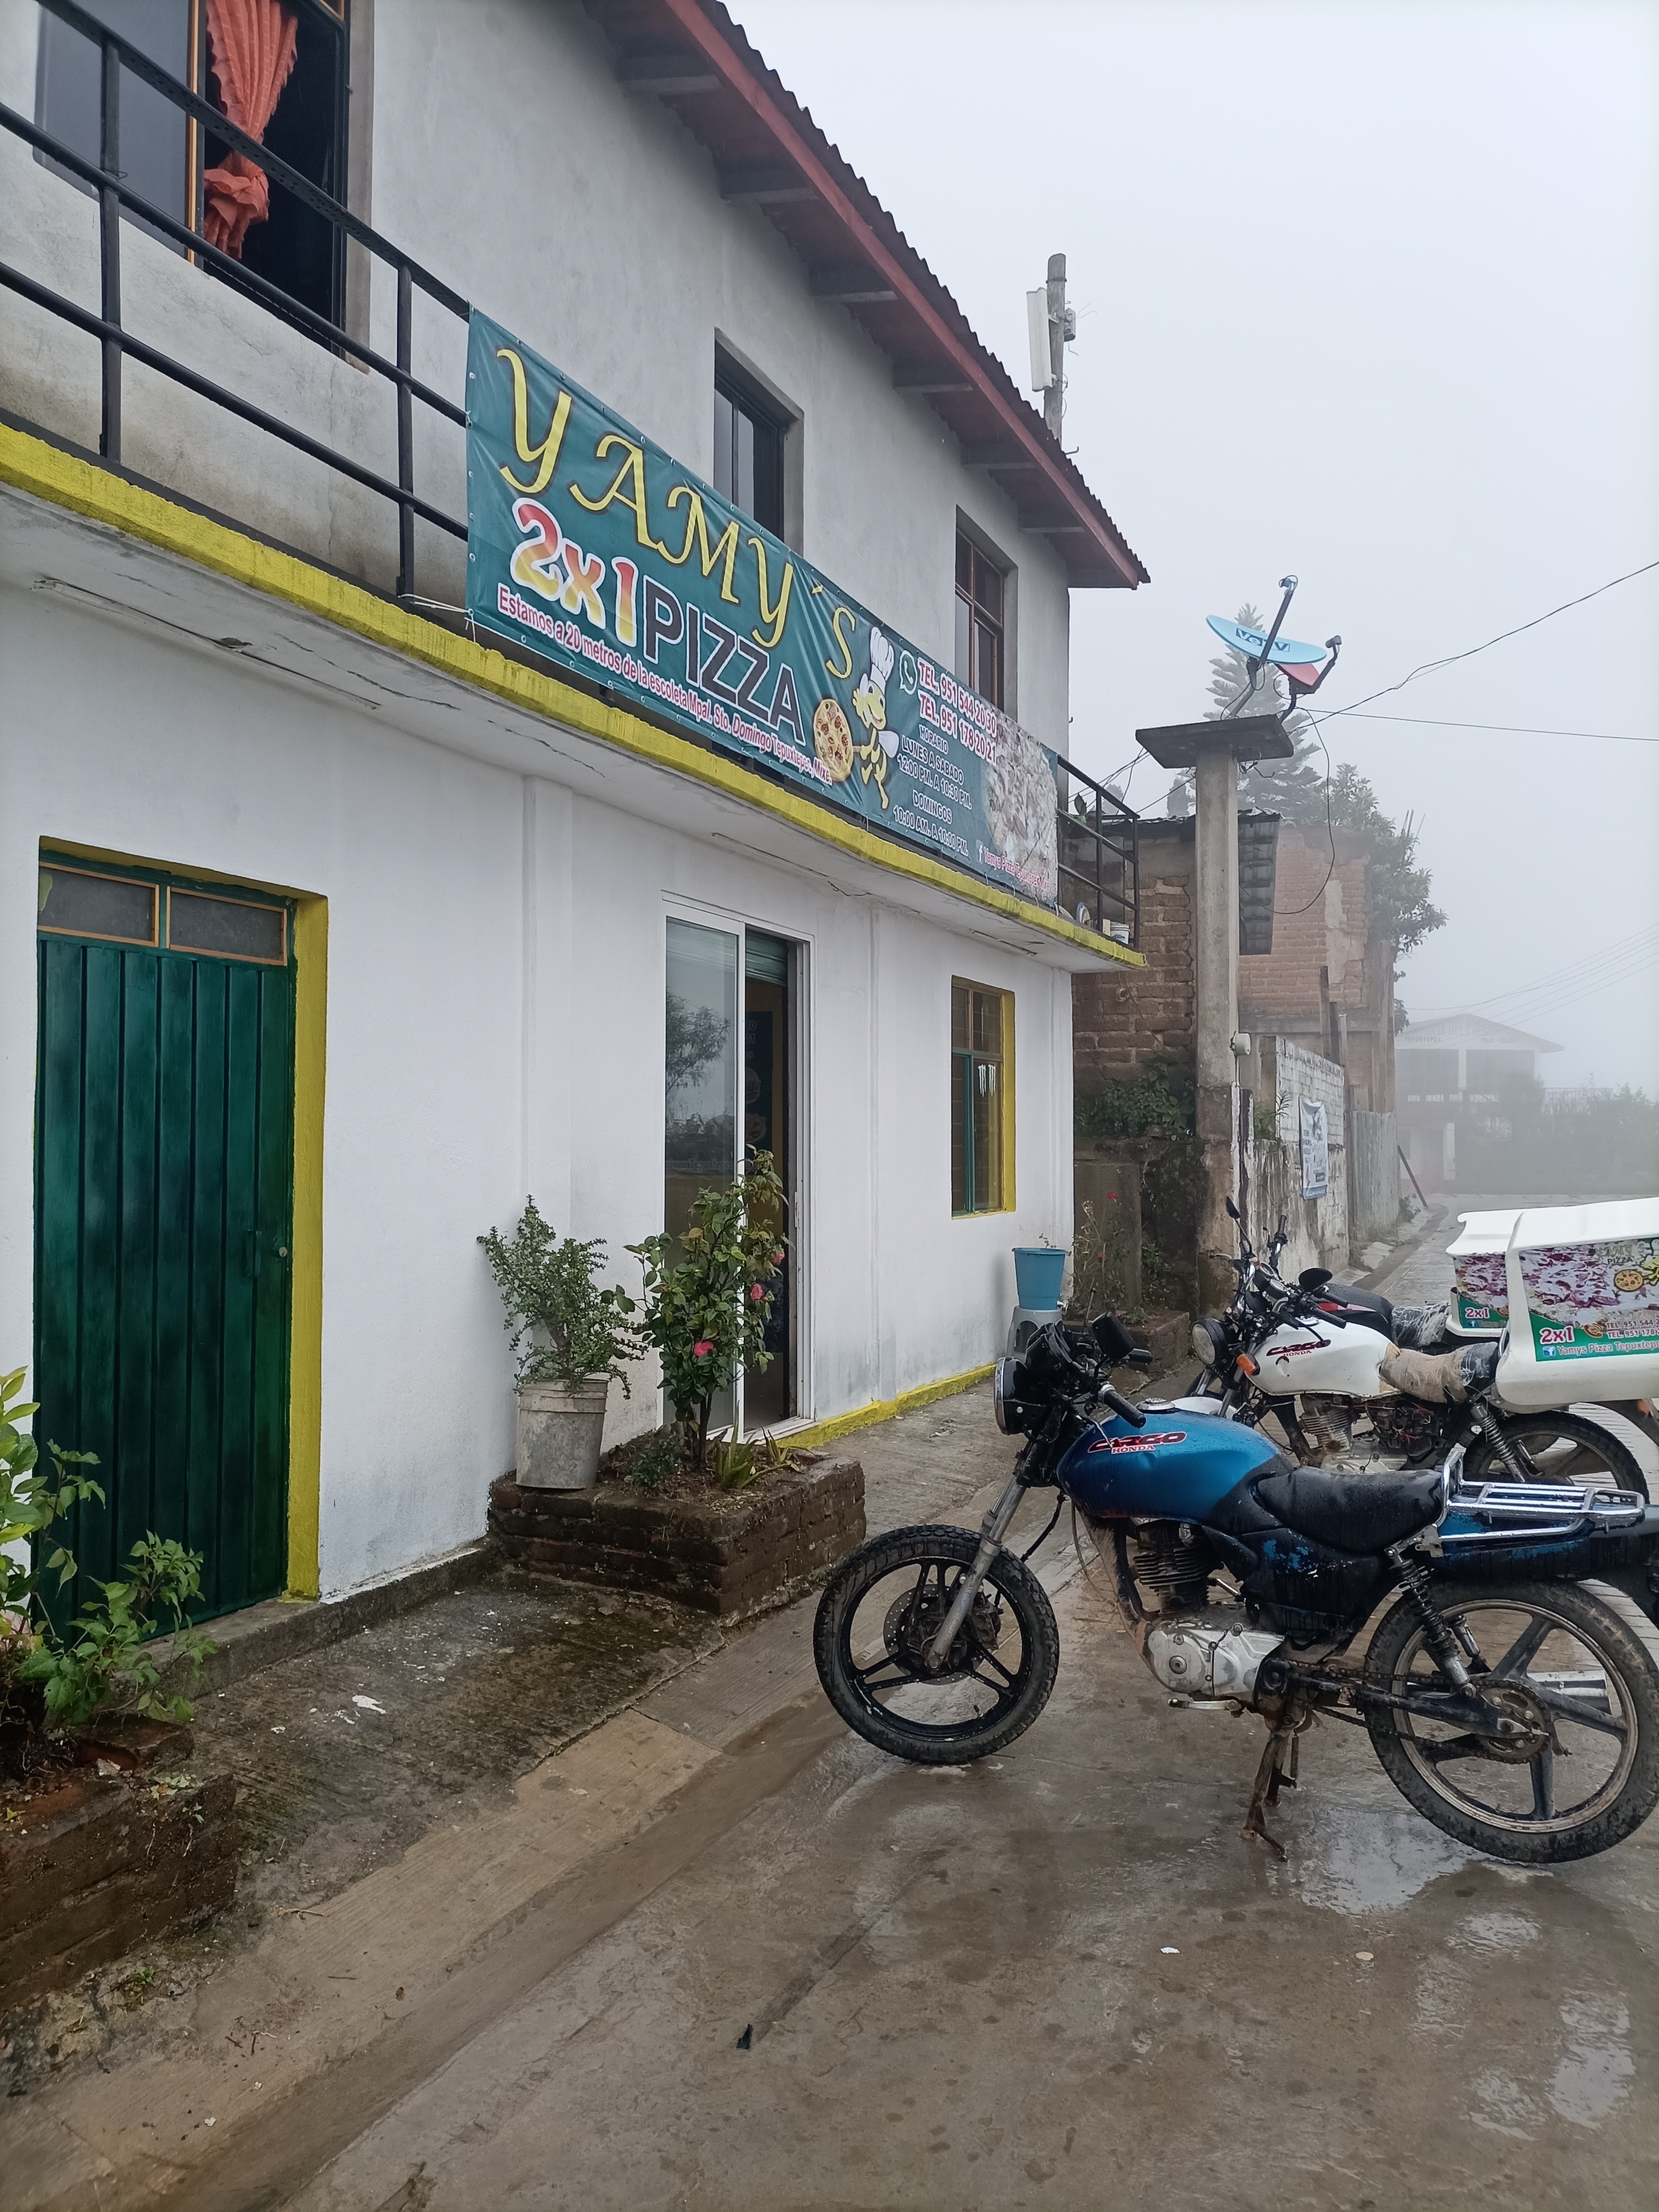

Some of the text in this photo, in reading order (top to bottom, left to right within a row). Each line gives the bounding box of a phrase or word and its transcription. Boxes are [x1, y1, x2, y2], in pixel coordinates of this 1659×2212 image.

[510, 498, 806, 746] 2x1 PIZZA
[498, 582, 554, 638] Estamos
[555, 621, 564, 645] a
[565, 621, 581, 652] 20
[581, 635, 621, 674] metros
[622, 654, 637, 682] de
[638, 660, 648, 688] la
[648, 672, 688, 711] escoleta
[688, 689, 712, 724] Mpal.
[714, 703, 731, 733] Sto.
[732, 713, 771, 753] Domingo
[917, 657, 997, 738] TEL. 951 544 20 30
[918, 690, 996, 766] TEL. 951 178 20 21
[919, 724, 948, 754] HORARIO
[902, 735, 964, 785] LUNES A SABADO
[898, 753, 972, 810] 12:00 PM. A 10:30 PM.
[913, 789, 952, 824] DOMINGOS
[894, 805, 968, 857] 10:00 AM. A 10:00 PM.
[1465, 1307, 1490, 1319] 2x1
[1540, 1325, 1575, 1344] 2x1
[1557, 1345, 1587, 1355] Yamys
[1589, 1343, 1613, 1353] Pizza
[1614, 1340, 1659, 1352] Tepuxtepe
[1624, 1329, 1639, 1338] 951
[1641, 1328, 1656, 1337] 178
[1087, 1431, 1187, 1453] CARGO
[1112, 1445, 1156, 1454] HONDA
